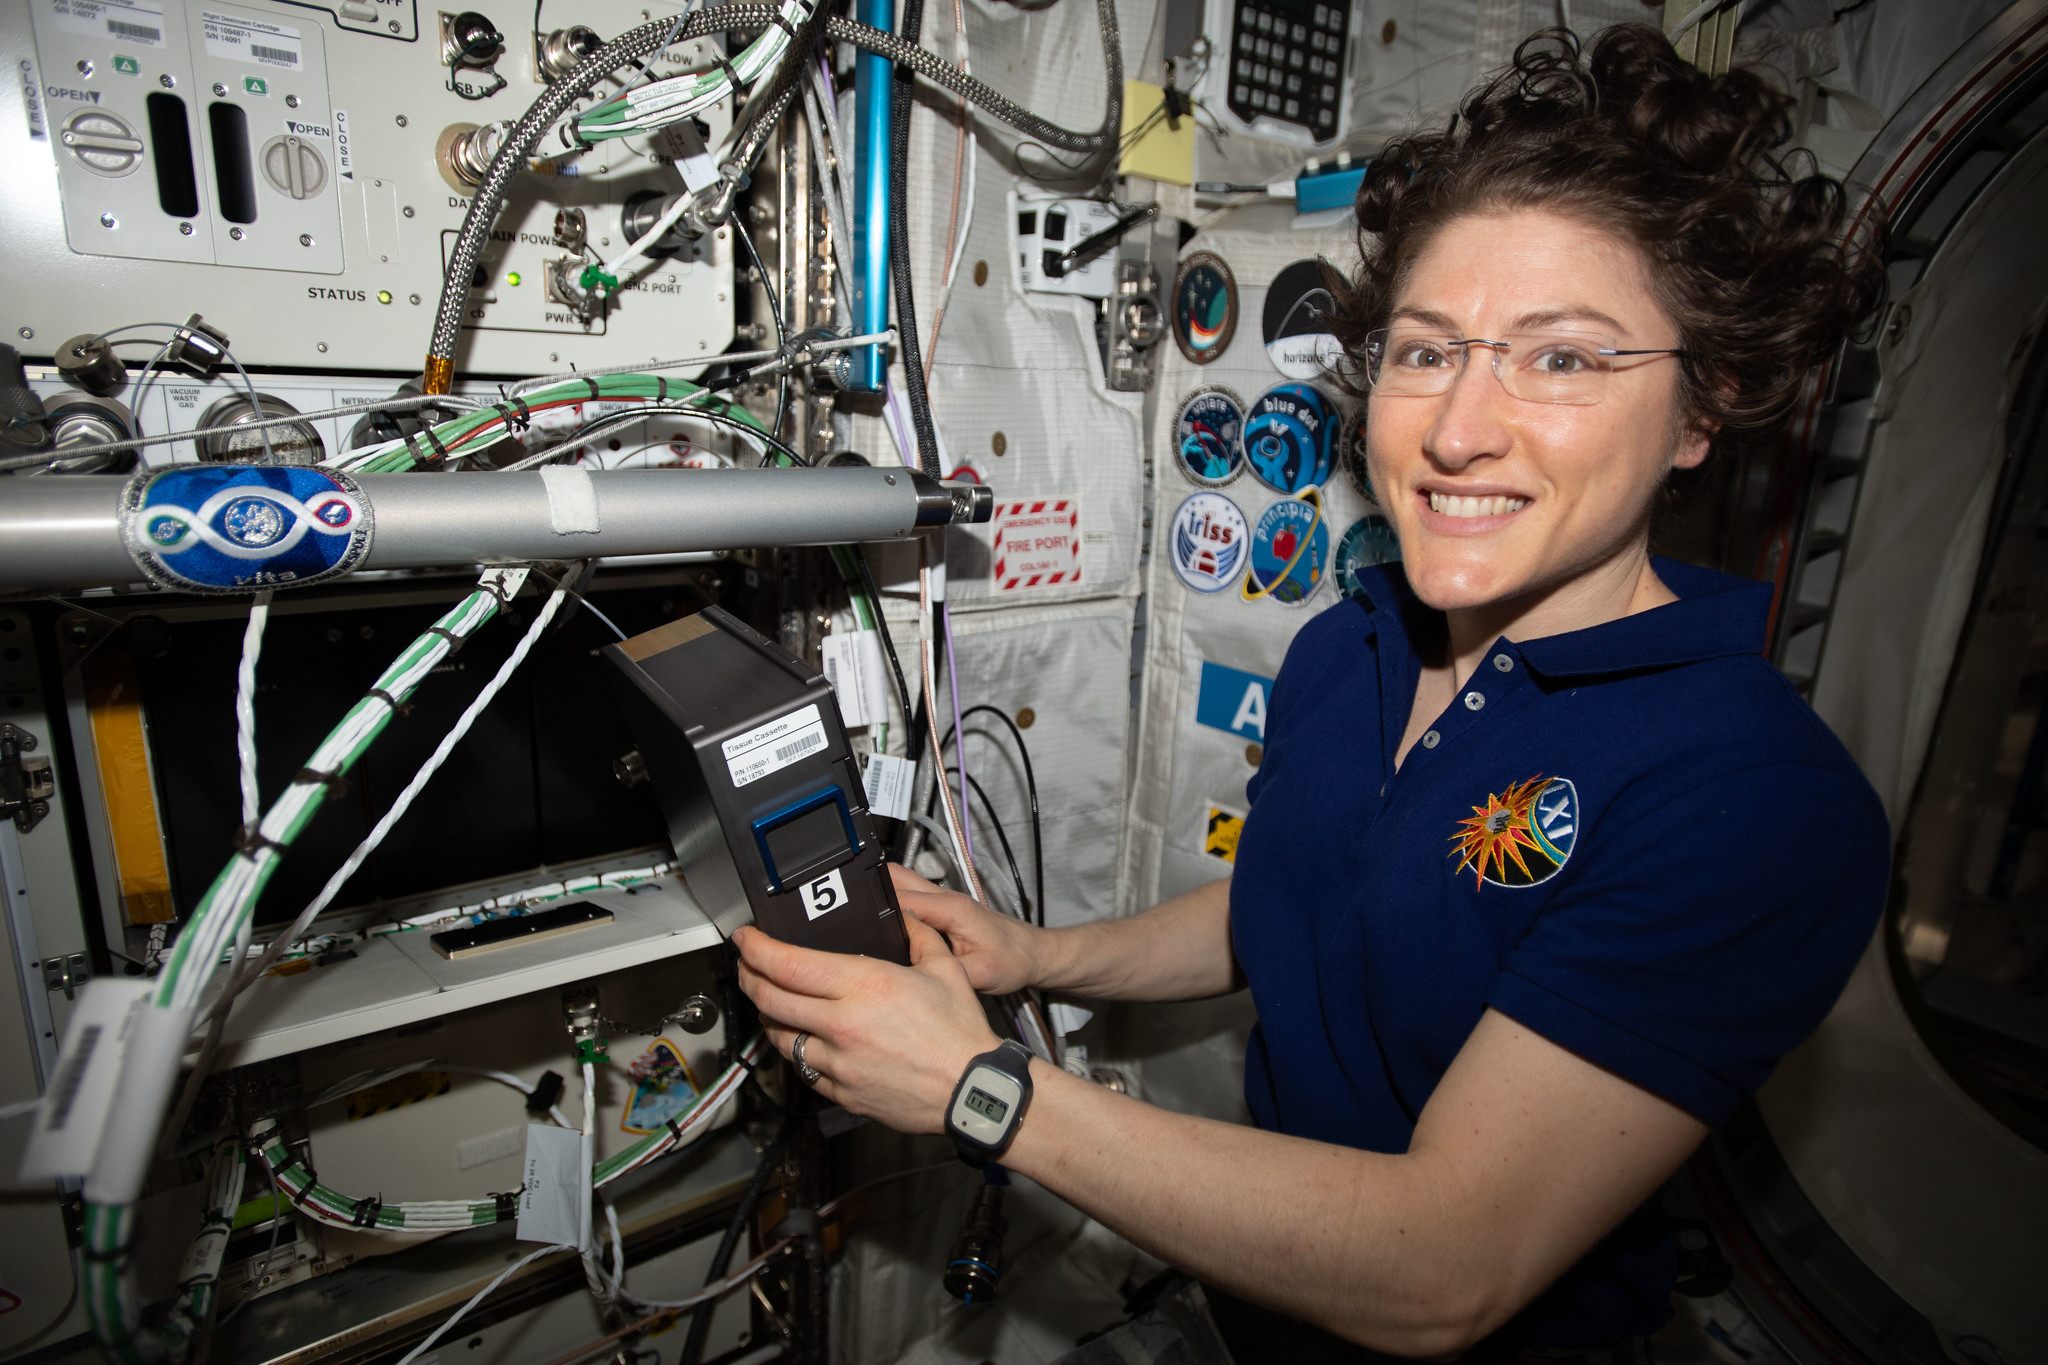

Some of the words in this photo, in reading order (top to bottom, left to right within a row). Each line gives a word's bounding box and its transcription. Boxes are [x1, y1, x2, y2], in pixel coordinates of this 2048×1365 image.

[202, 12, 220, 21] Right
[221, 16, 252, 27] Desiccant
[252, 22, 281, 33] Cartridge
[204, 24, 219, 33] P/N
[219, 27, 252, 39] 109487-1
[205, 32, 219, 40] S/N
[220, 34, 242, 45] 14091
[660, 50, 693, 66] FLOW
[19, 59, 41, 124] CLOSE
[46, 86, 91, 102] OPEN
[445, 80, 474, 95] USB
[296, 123, 331, 138] OPEN
[336, 112, 350, 167] CLOSE
[307, 287, 367, 302] STATUS
[651, 282, 683, 295] PORT
[470, 307, 486, 319] cb
[544, 312, 575, 324] PWR
[168, 388, 201, 397] VACUUM
[172, 395, 199, 403] WASTE
[178, 401, 195, 409] GAS
[599, 403, 630, 411] SMOKE
[1192, 396, 1229, 416] volare
[1263, 396, 1297, 415] blue
[1296, 405, 1320, 432] dot
[1003, 517, 1052, 529] EMERGENCY
[1053, 515, 1071, 525] USE
[1189, 510, 1235, 544] iriss
[1256, 502, 1315, 544] principia
[339, 528, 367, 571] NESPOLI
[1006, 540, 1033, 554] FIRE
[1035, 535, 1070, 550] PORT
[234, 570, 298, 587] vita
[1230, 680, 1267, 739] A
[726, 738, 753, 754] Tissue
[754, 723, 788, 742] Cassette
[734, 768, 745, 778] P/N
[745, 757, 770, 773] 110650-1
[736, 776, 748, 786] S/N
[748, 768, 765, 780] 18793
[811, 875, 837, 911] 5
